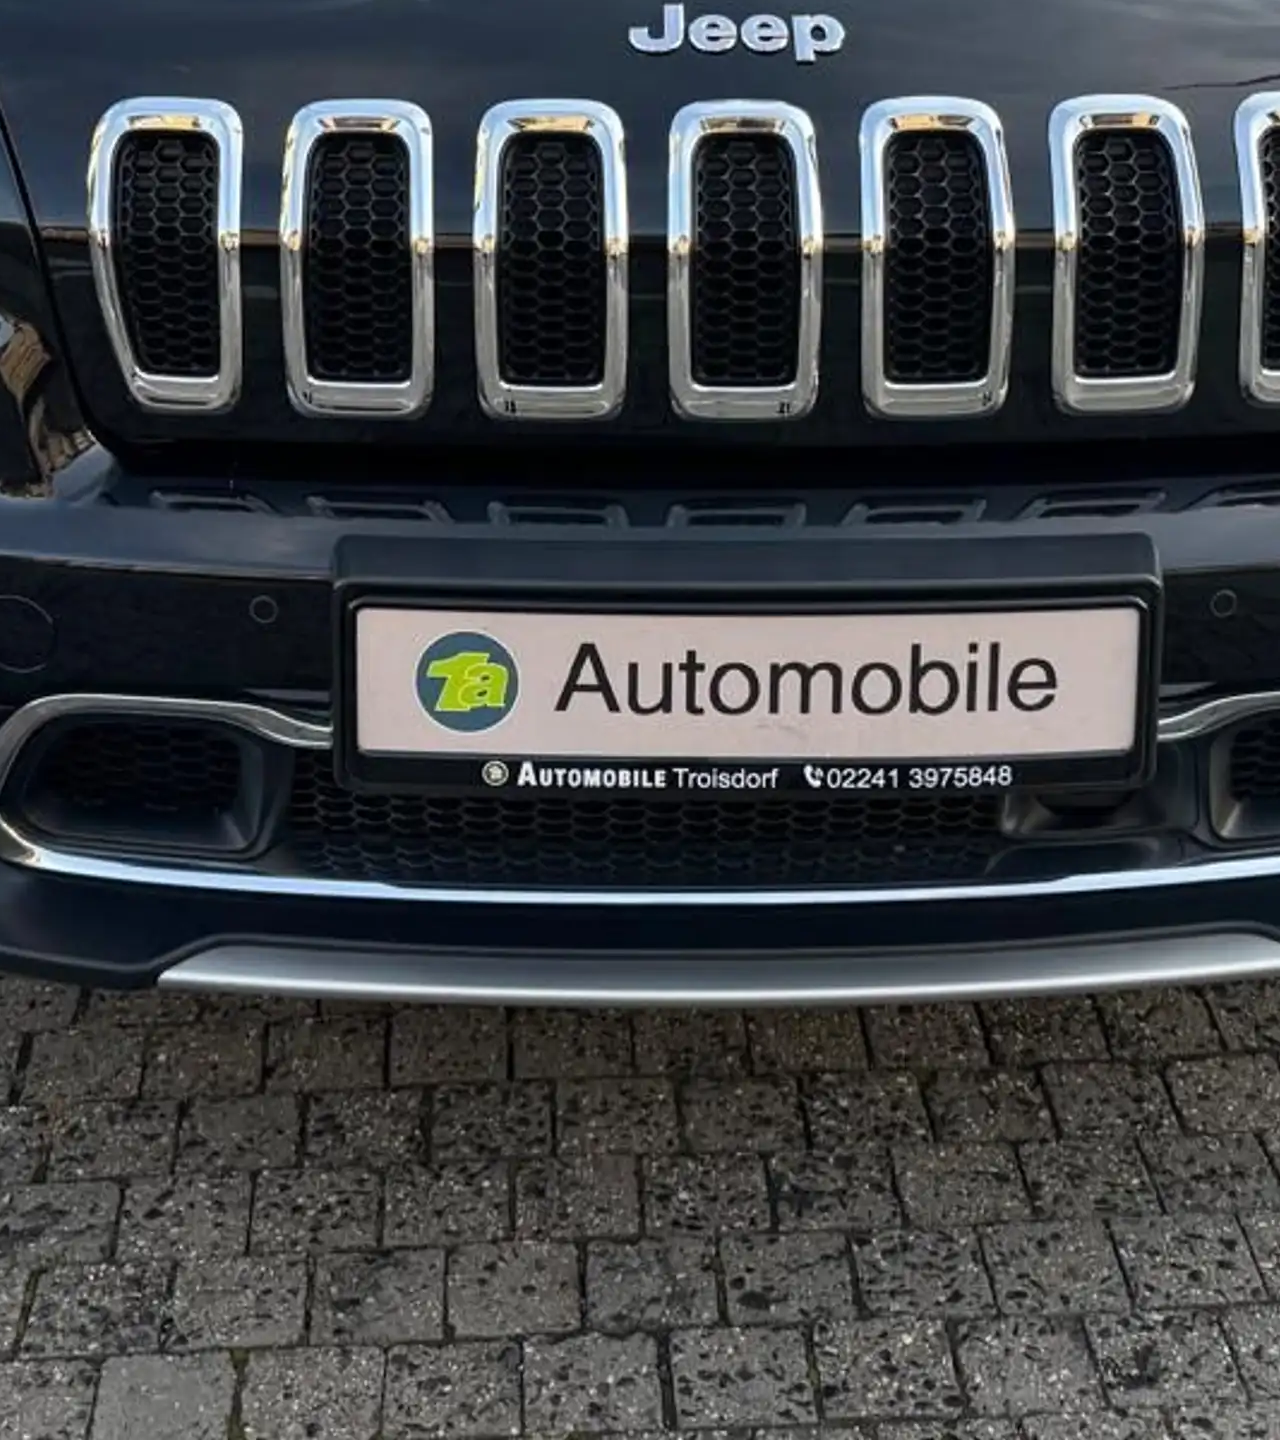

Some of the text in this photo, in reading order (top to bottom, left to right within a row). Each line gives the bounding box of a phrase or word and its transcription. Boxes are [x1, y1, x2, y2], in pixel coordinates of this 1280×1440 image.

[628, 2, 846, 62] Jeep
[426, 641, 1057, 715] 1a Automobile
[517, 761, 667, 788] AUTOMOBILE
[672, 766, 780, 789] Troisdorf
[826, 767, 899, 789] 02241
[908, 765, 1013, 788] 3975848
